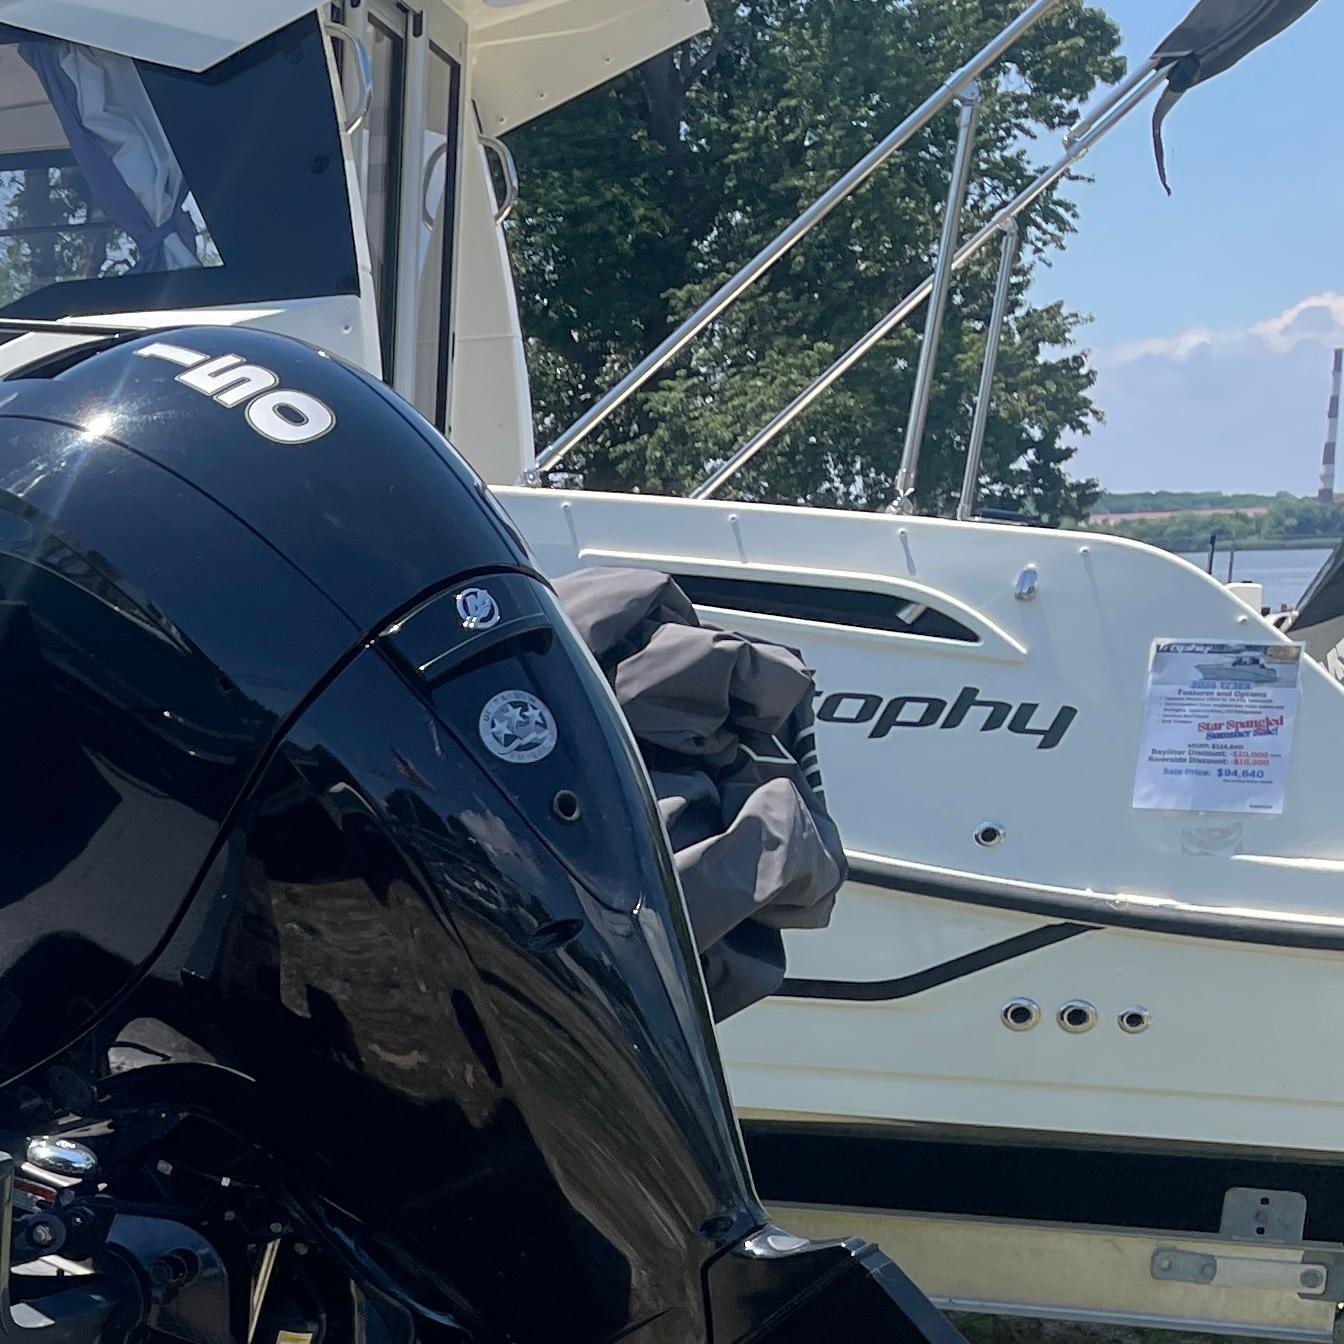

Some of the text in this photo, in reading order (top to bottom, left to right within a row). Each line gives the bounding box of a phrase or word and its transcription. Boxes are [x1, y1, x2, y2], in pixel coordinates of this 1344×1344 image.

[133, 342, 336, 445] 150
[813, 686, 1078, 750] ophy
[1198, 715, 1284, 732] Star Spangled
[1217, 768, 1265, 779] $94,640
